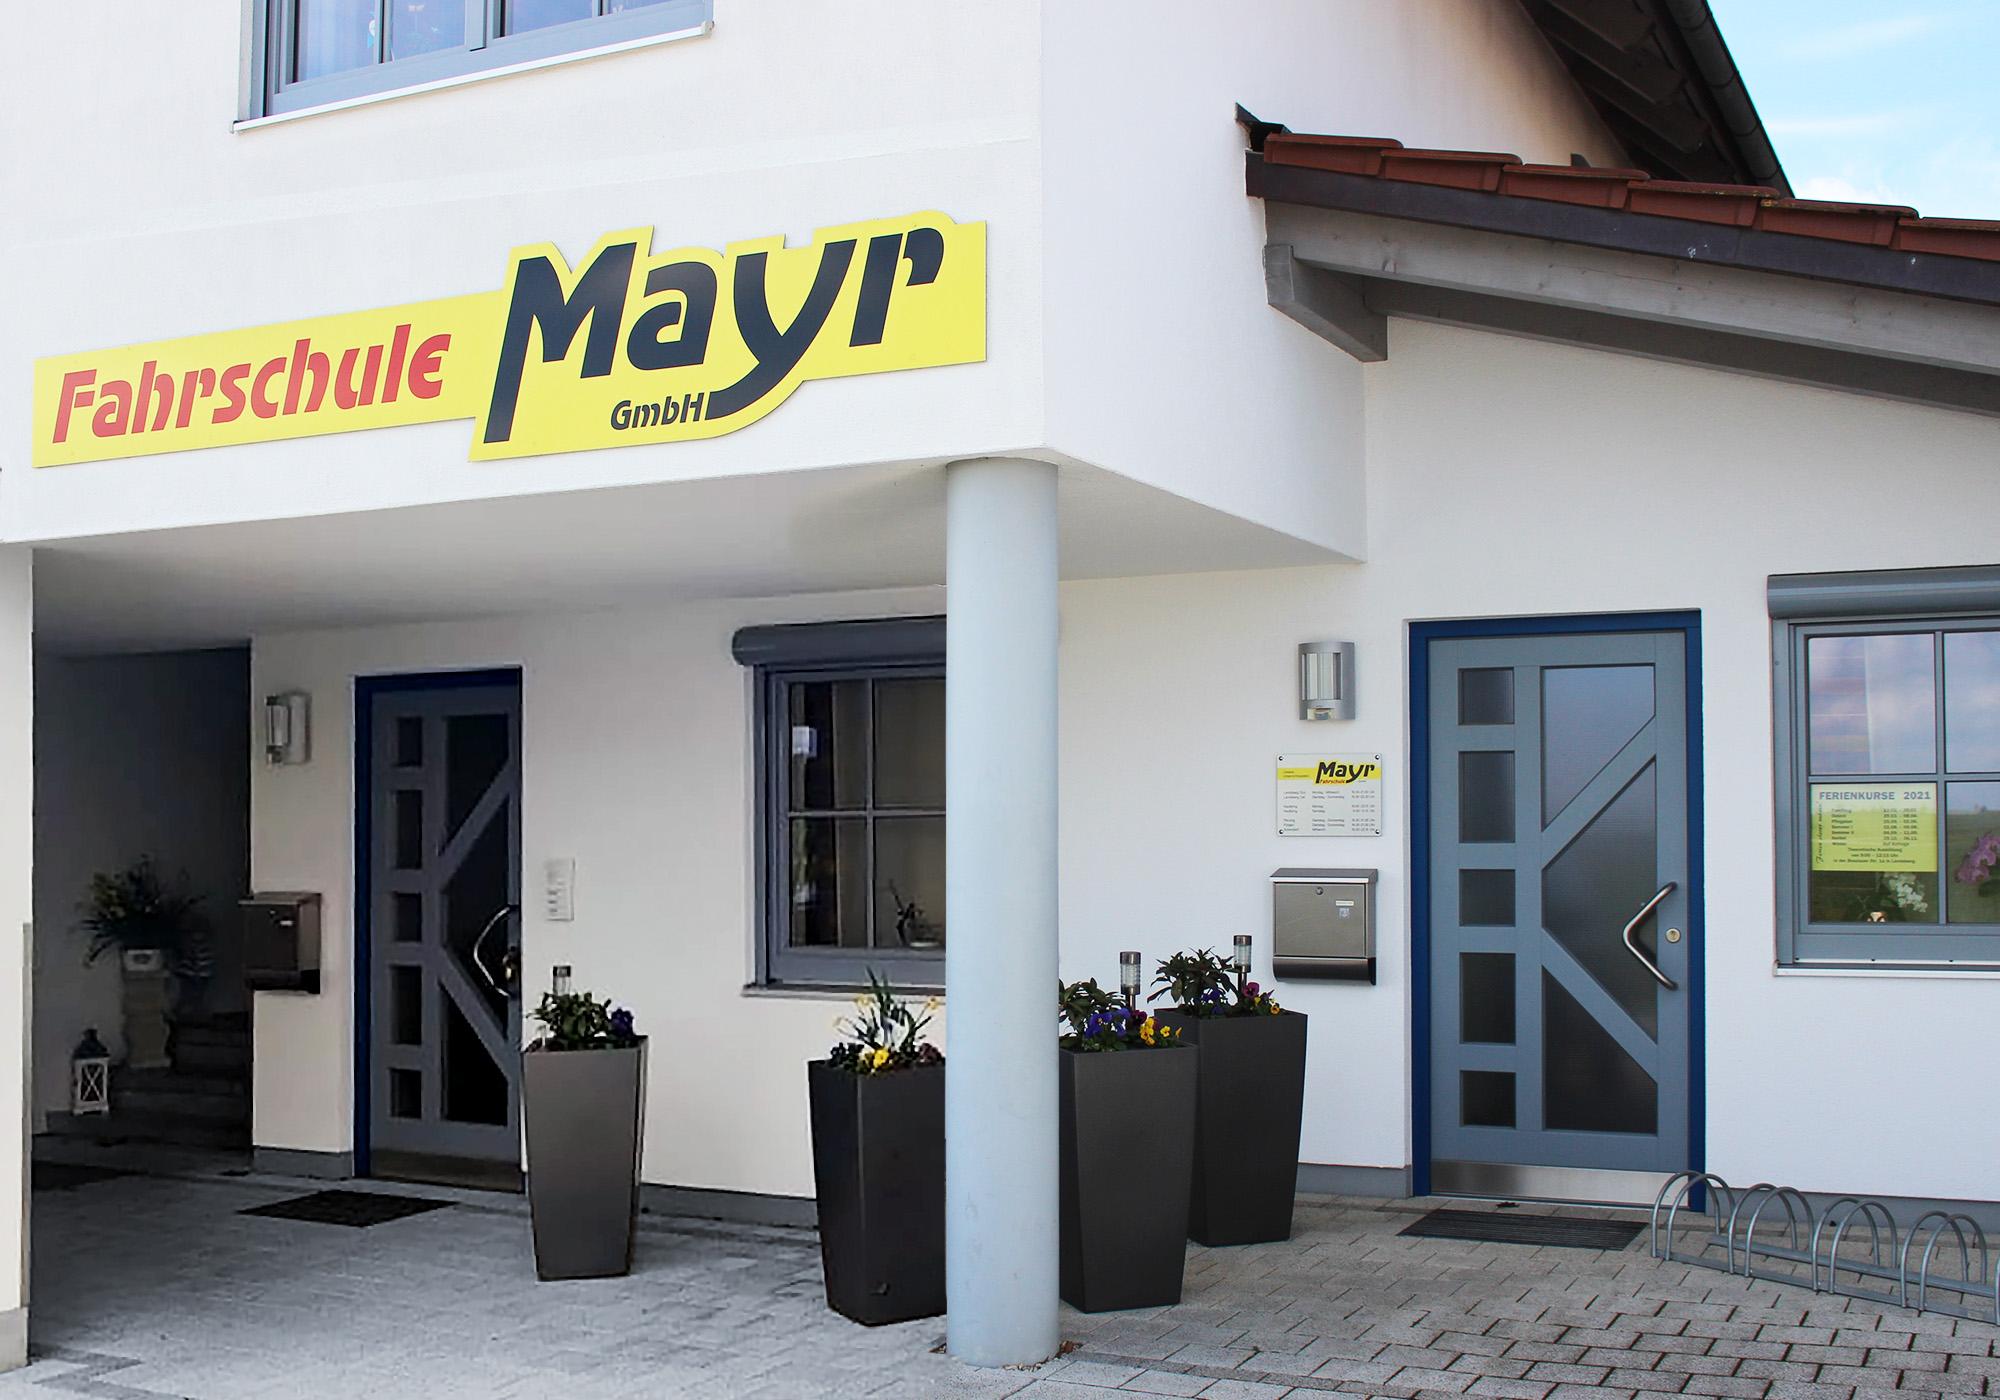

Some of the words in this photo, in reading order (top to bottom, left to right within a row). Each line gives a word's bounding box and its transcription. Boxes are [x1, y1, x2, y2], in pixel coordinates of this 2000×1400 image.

[52, 323, 452, 444] Fahrschule
[483, 227, 944, 443] Mayr
[610, 393, 705, 431] GmbH
[1316, 761, 1375, 784] Mayr
[1819, 791, 1895, 800] FERIENKURSE
[1903, 791, 1931, 800] 2021
